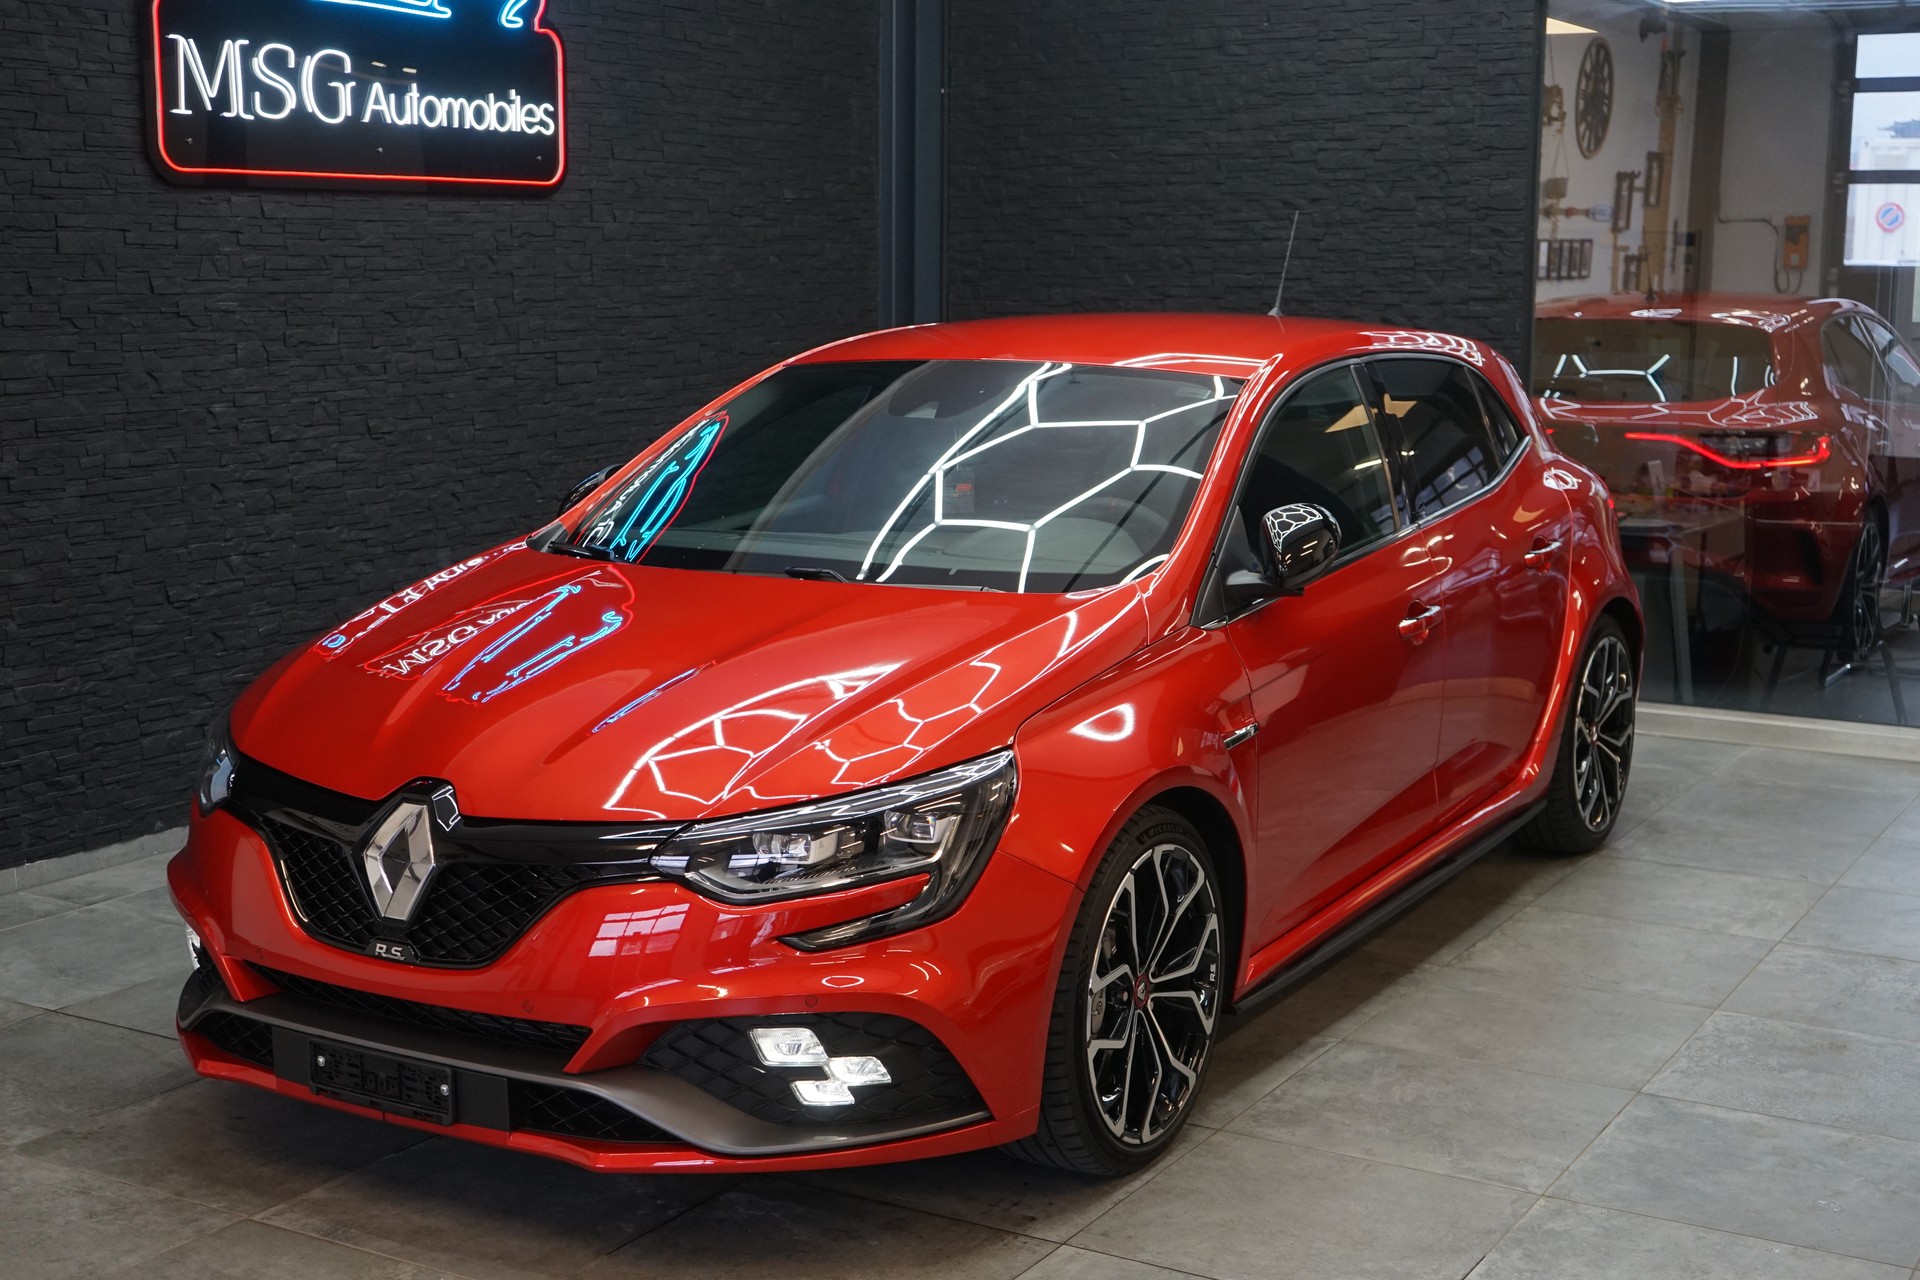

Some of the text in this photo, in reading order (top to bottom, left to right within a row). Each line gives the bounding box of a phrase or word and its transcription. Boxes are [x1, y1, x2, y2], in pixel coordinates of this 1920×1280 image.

[166, 34, 555, 136] MSG Automobiles
[1148, 822, 1184, 837] MICHELIN
